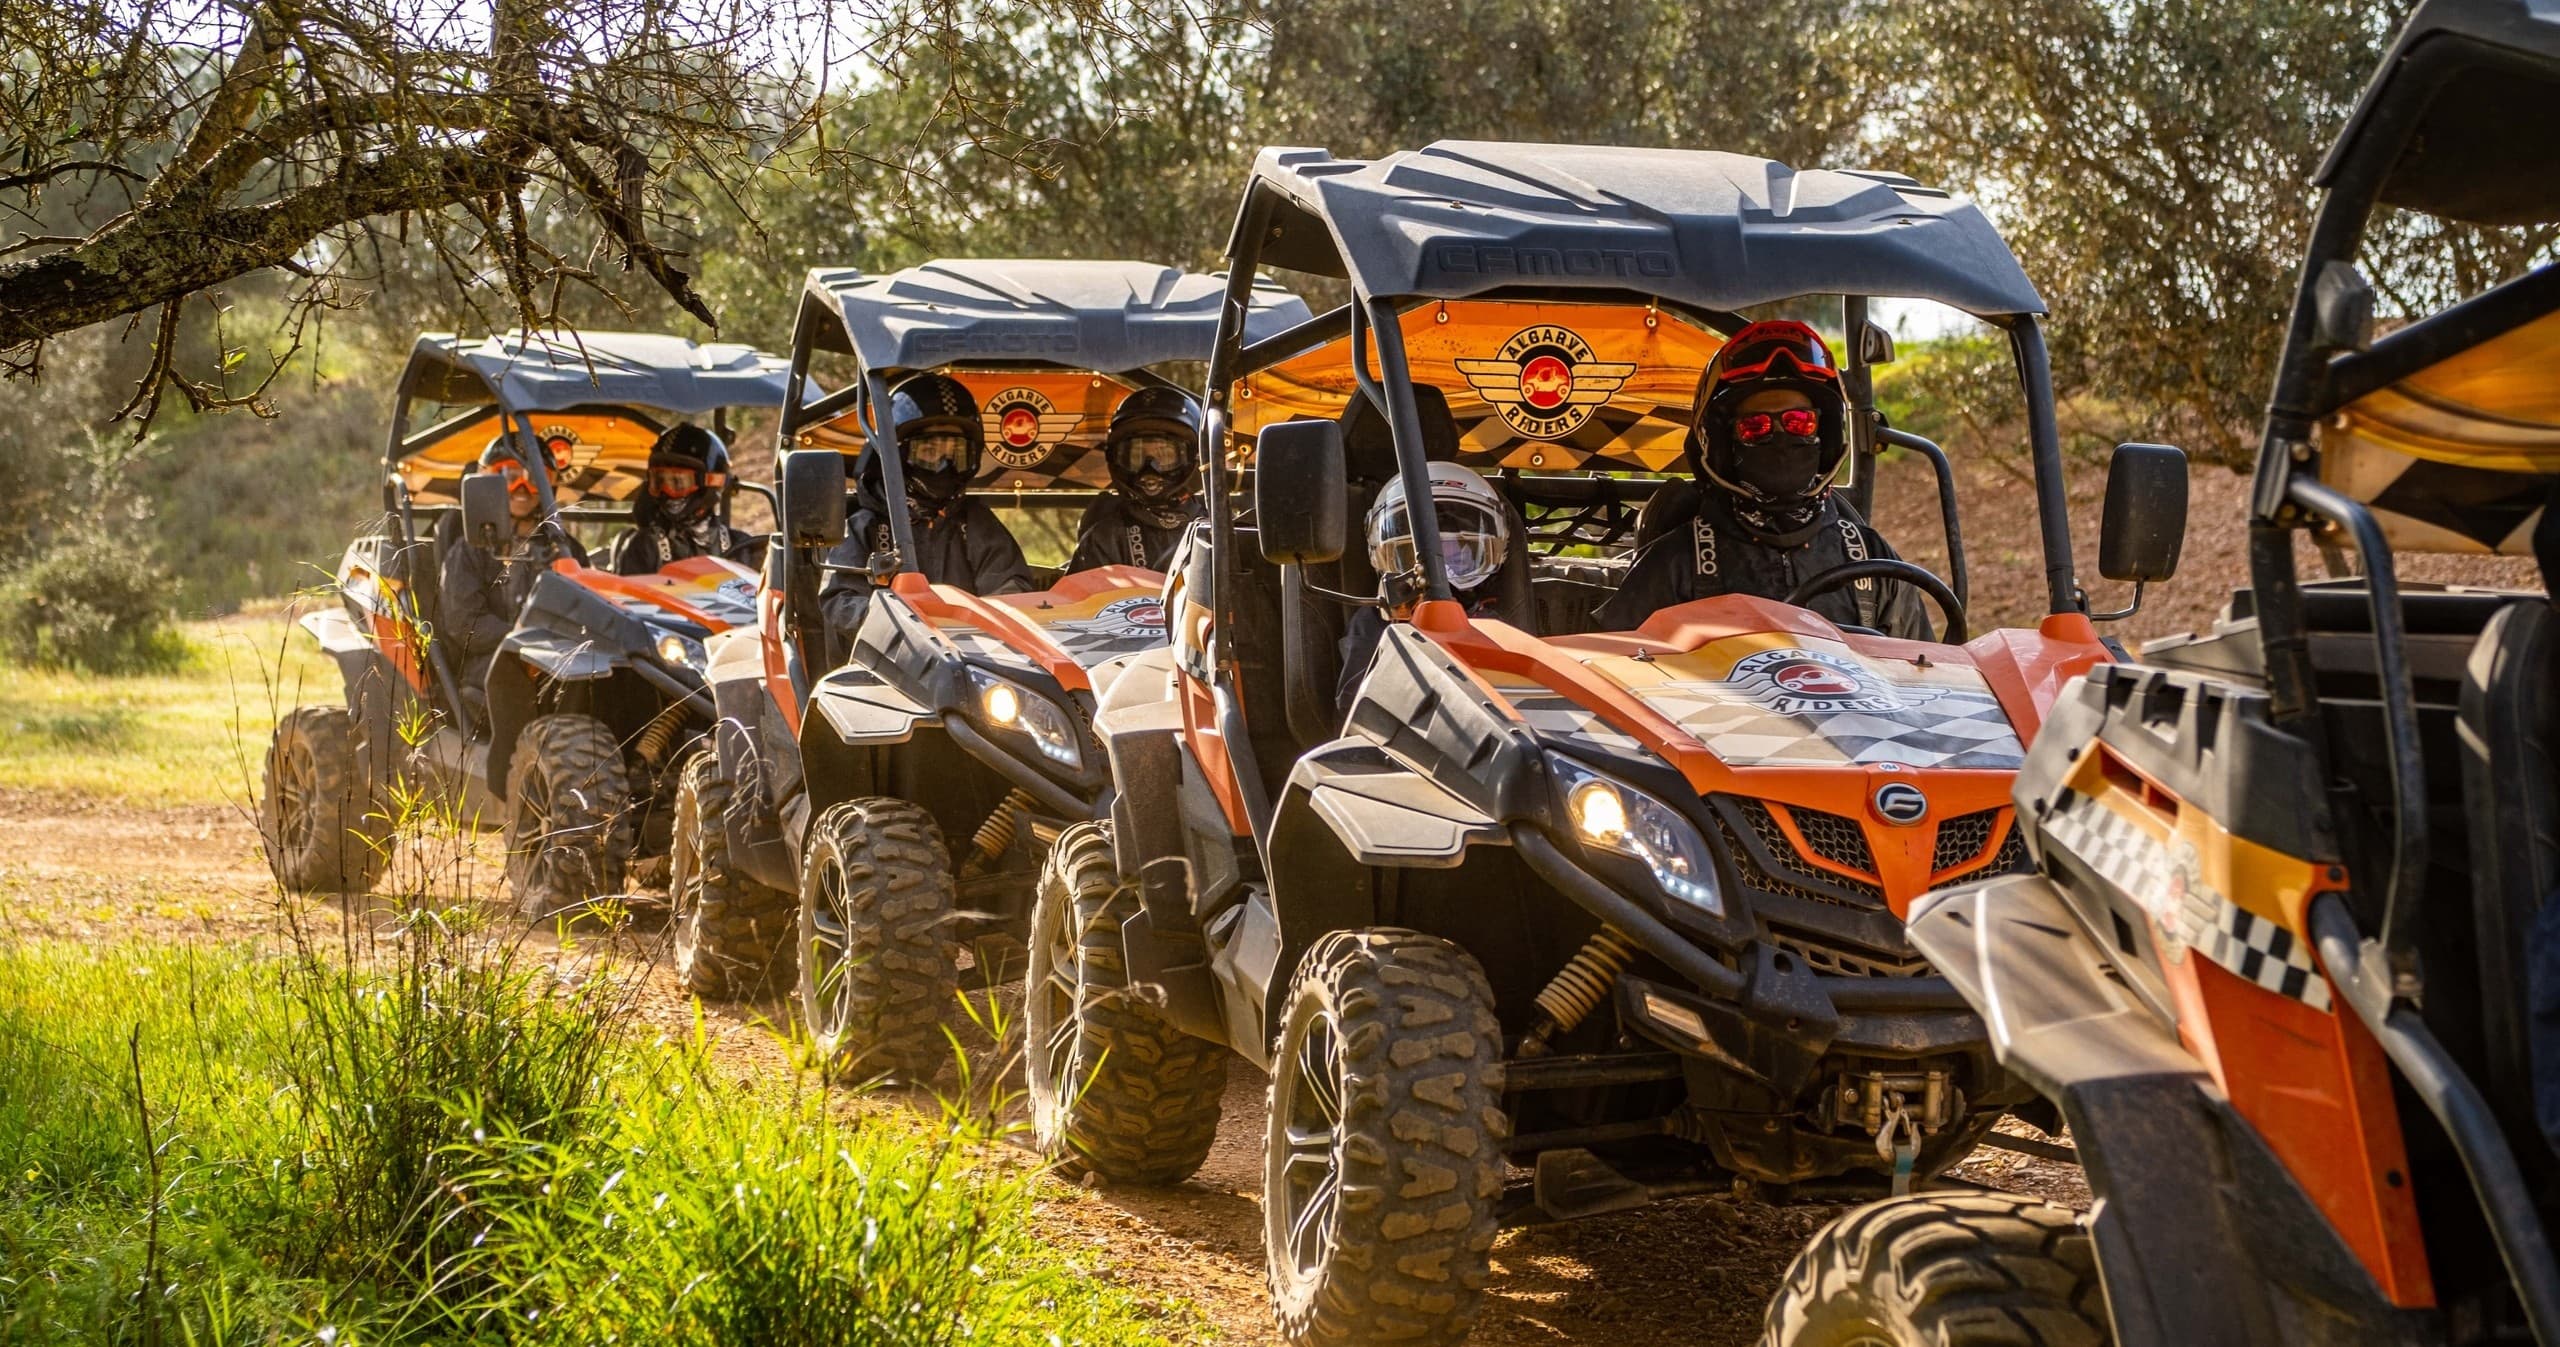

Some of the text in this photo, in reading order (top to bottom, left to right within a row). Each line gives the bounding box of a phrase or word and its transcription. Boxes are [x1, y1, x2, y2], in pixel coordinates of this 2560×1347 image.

[1438, 244, 1677, 278] CFMOTO
[1505, 328, 1589, 361] ALGARVE
[991, 390, 1050, 413] ALGARVE
[1506, 406, 1583, 435] RIDERS
[992, 444, 1047, 465] RIDERS
[1739, 650, 1865, 675] ALGARVE
[1771, 696, 1893, 712] RIDERS
